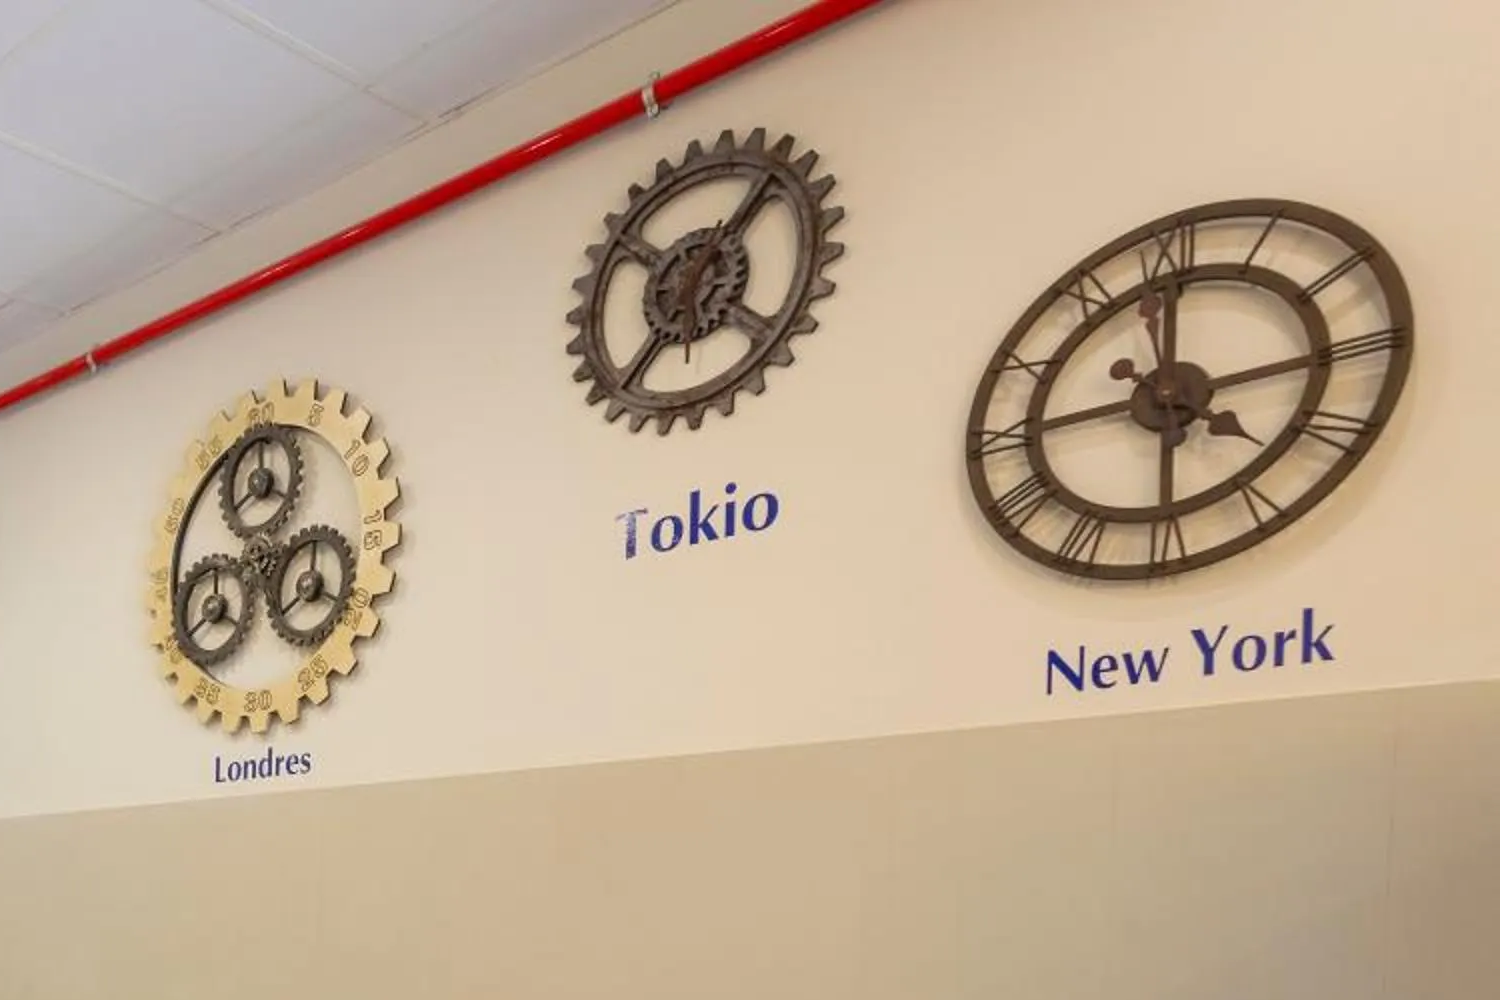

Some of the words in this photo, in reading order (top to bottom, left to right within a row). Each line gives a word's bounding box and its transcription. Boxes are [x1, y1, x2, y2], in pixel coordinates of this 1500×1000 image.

[615, 481, 780, 560] Tokio
[1045, 645, 1170, 697] New
[1190, 607, 1336, 677] York
[214, 747, 312, 783] Londres
